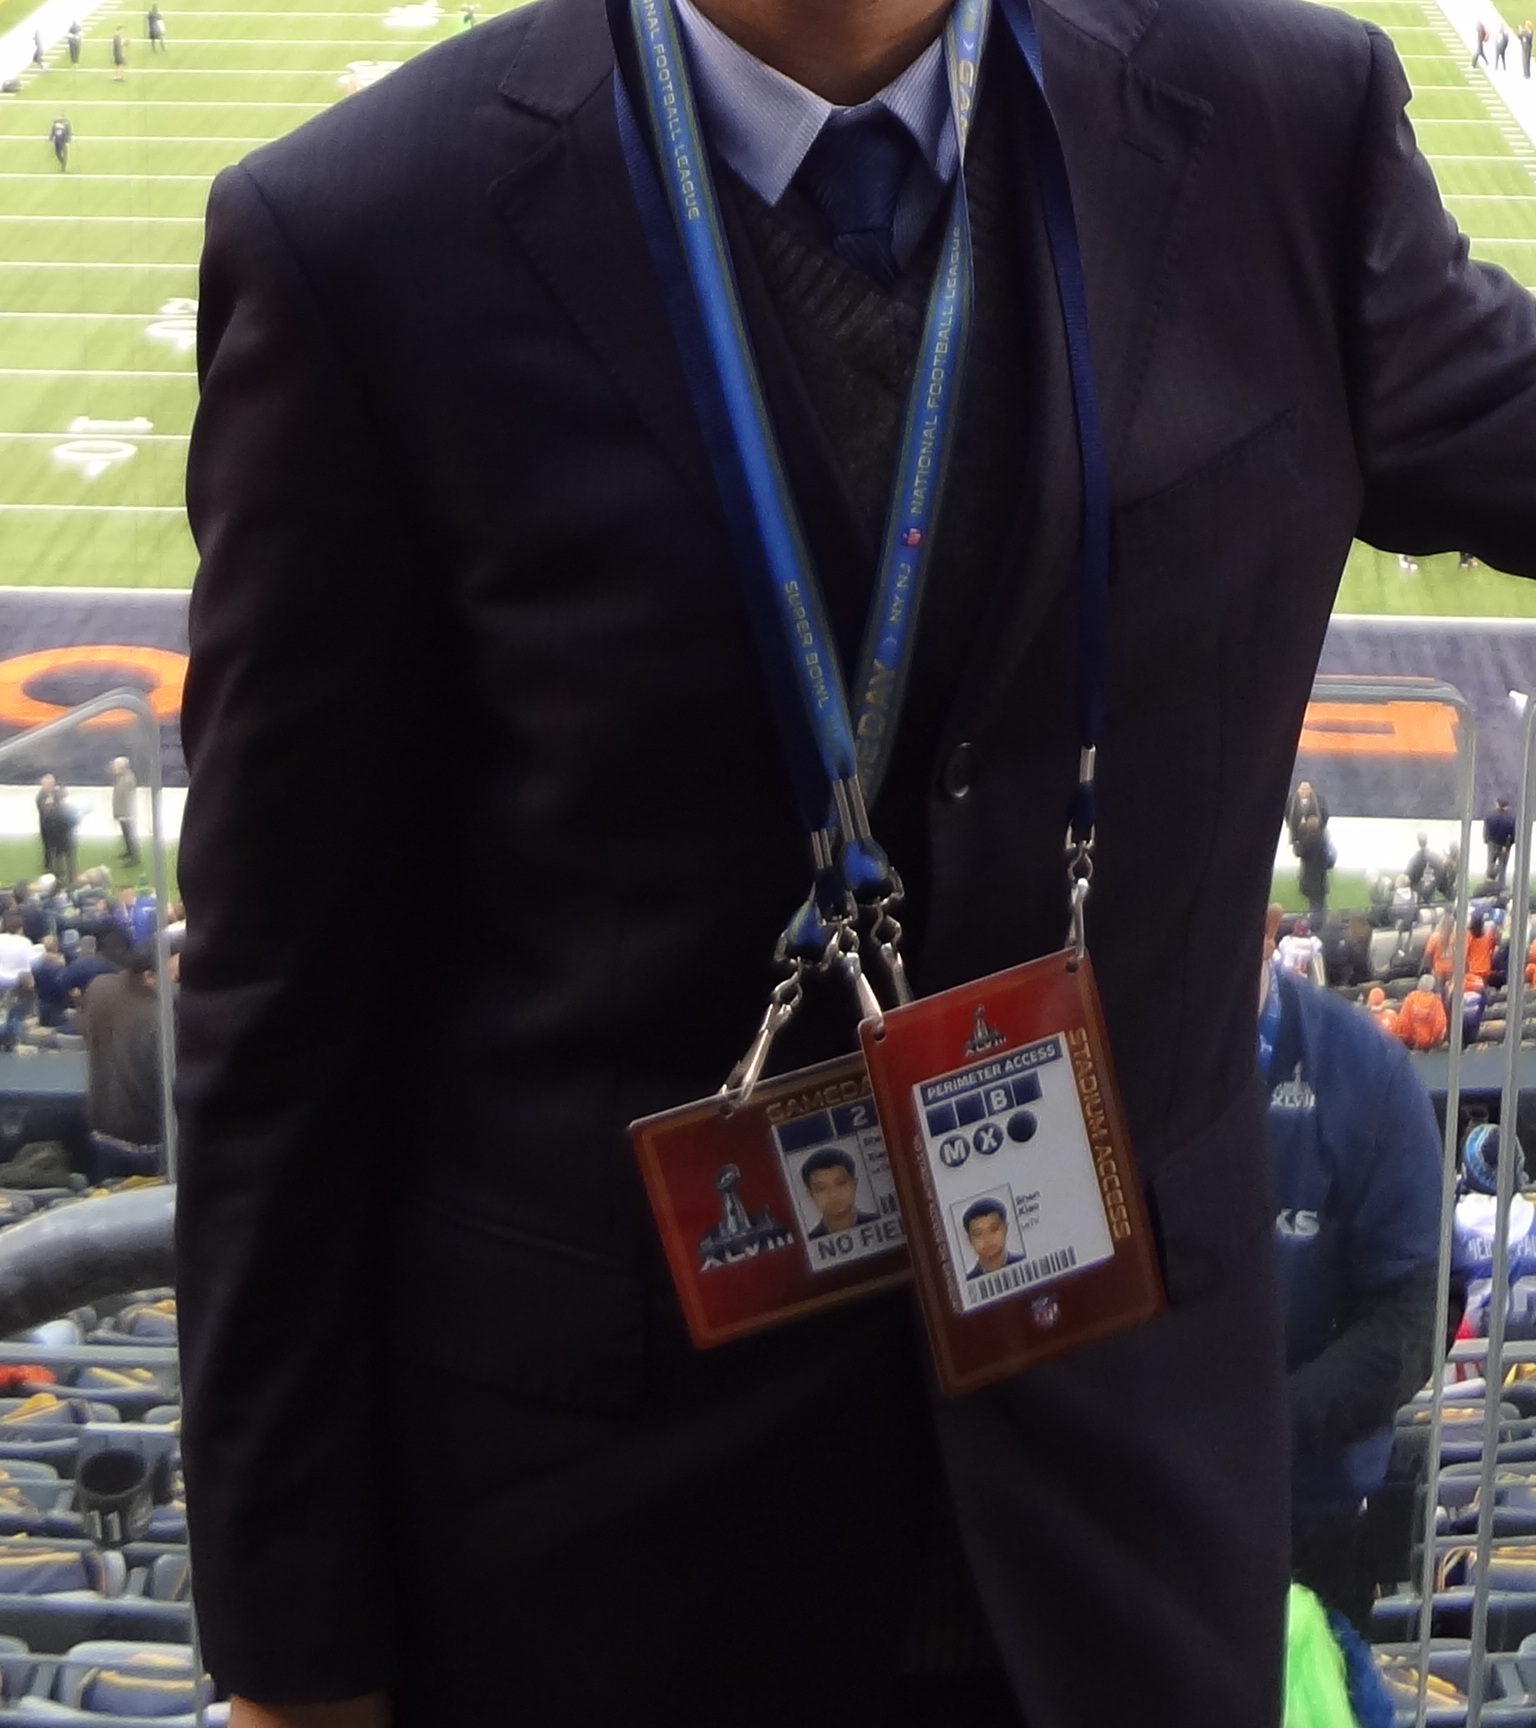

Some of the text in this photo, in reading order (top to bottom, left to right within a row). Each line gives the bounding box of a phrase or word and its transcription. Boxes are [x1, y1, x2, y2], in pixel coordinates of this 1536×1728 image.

[653, 43, 681, 142] FOOTBALL
[673, 144, 700, 221] LEAGUE
[911, 225, 961, 515] NATIONAL FOOTBALL LEAGUE
[785, 580, 830, 708] SUPER BOWL
[926, 1043, 1056, 1100] PERIMETER ACCESS
[851, 1106, 869, 1127] 2
[990, 1089, 1007, 1111] B
[944, 1127, 998, 1163] M X
[1068, 1027, 1132, 1239] STADIUM ACCESS
[699, 1231, 795, 1272] XLVIII
[817, 1235, 854, 1260] NO
[88, 1510, 122, 1543] 11
